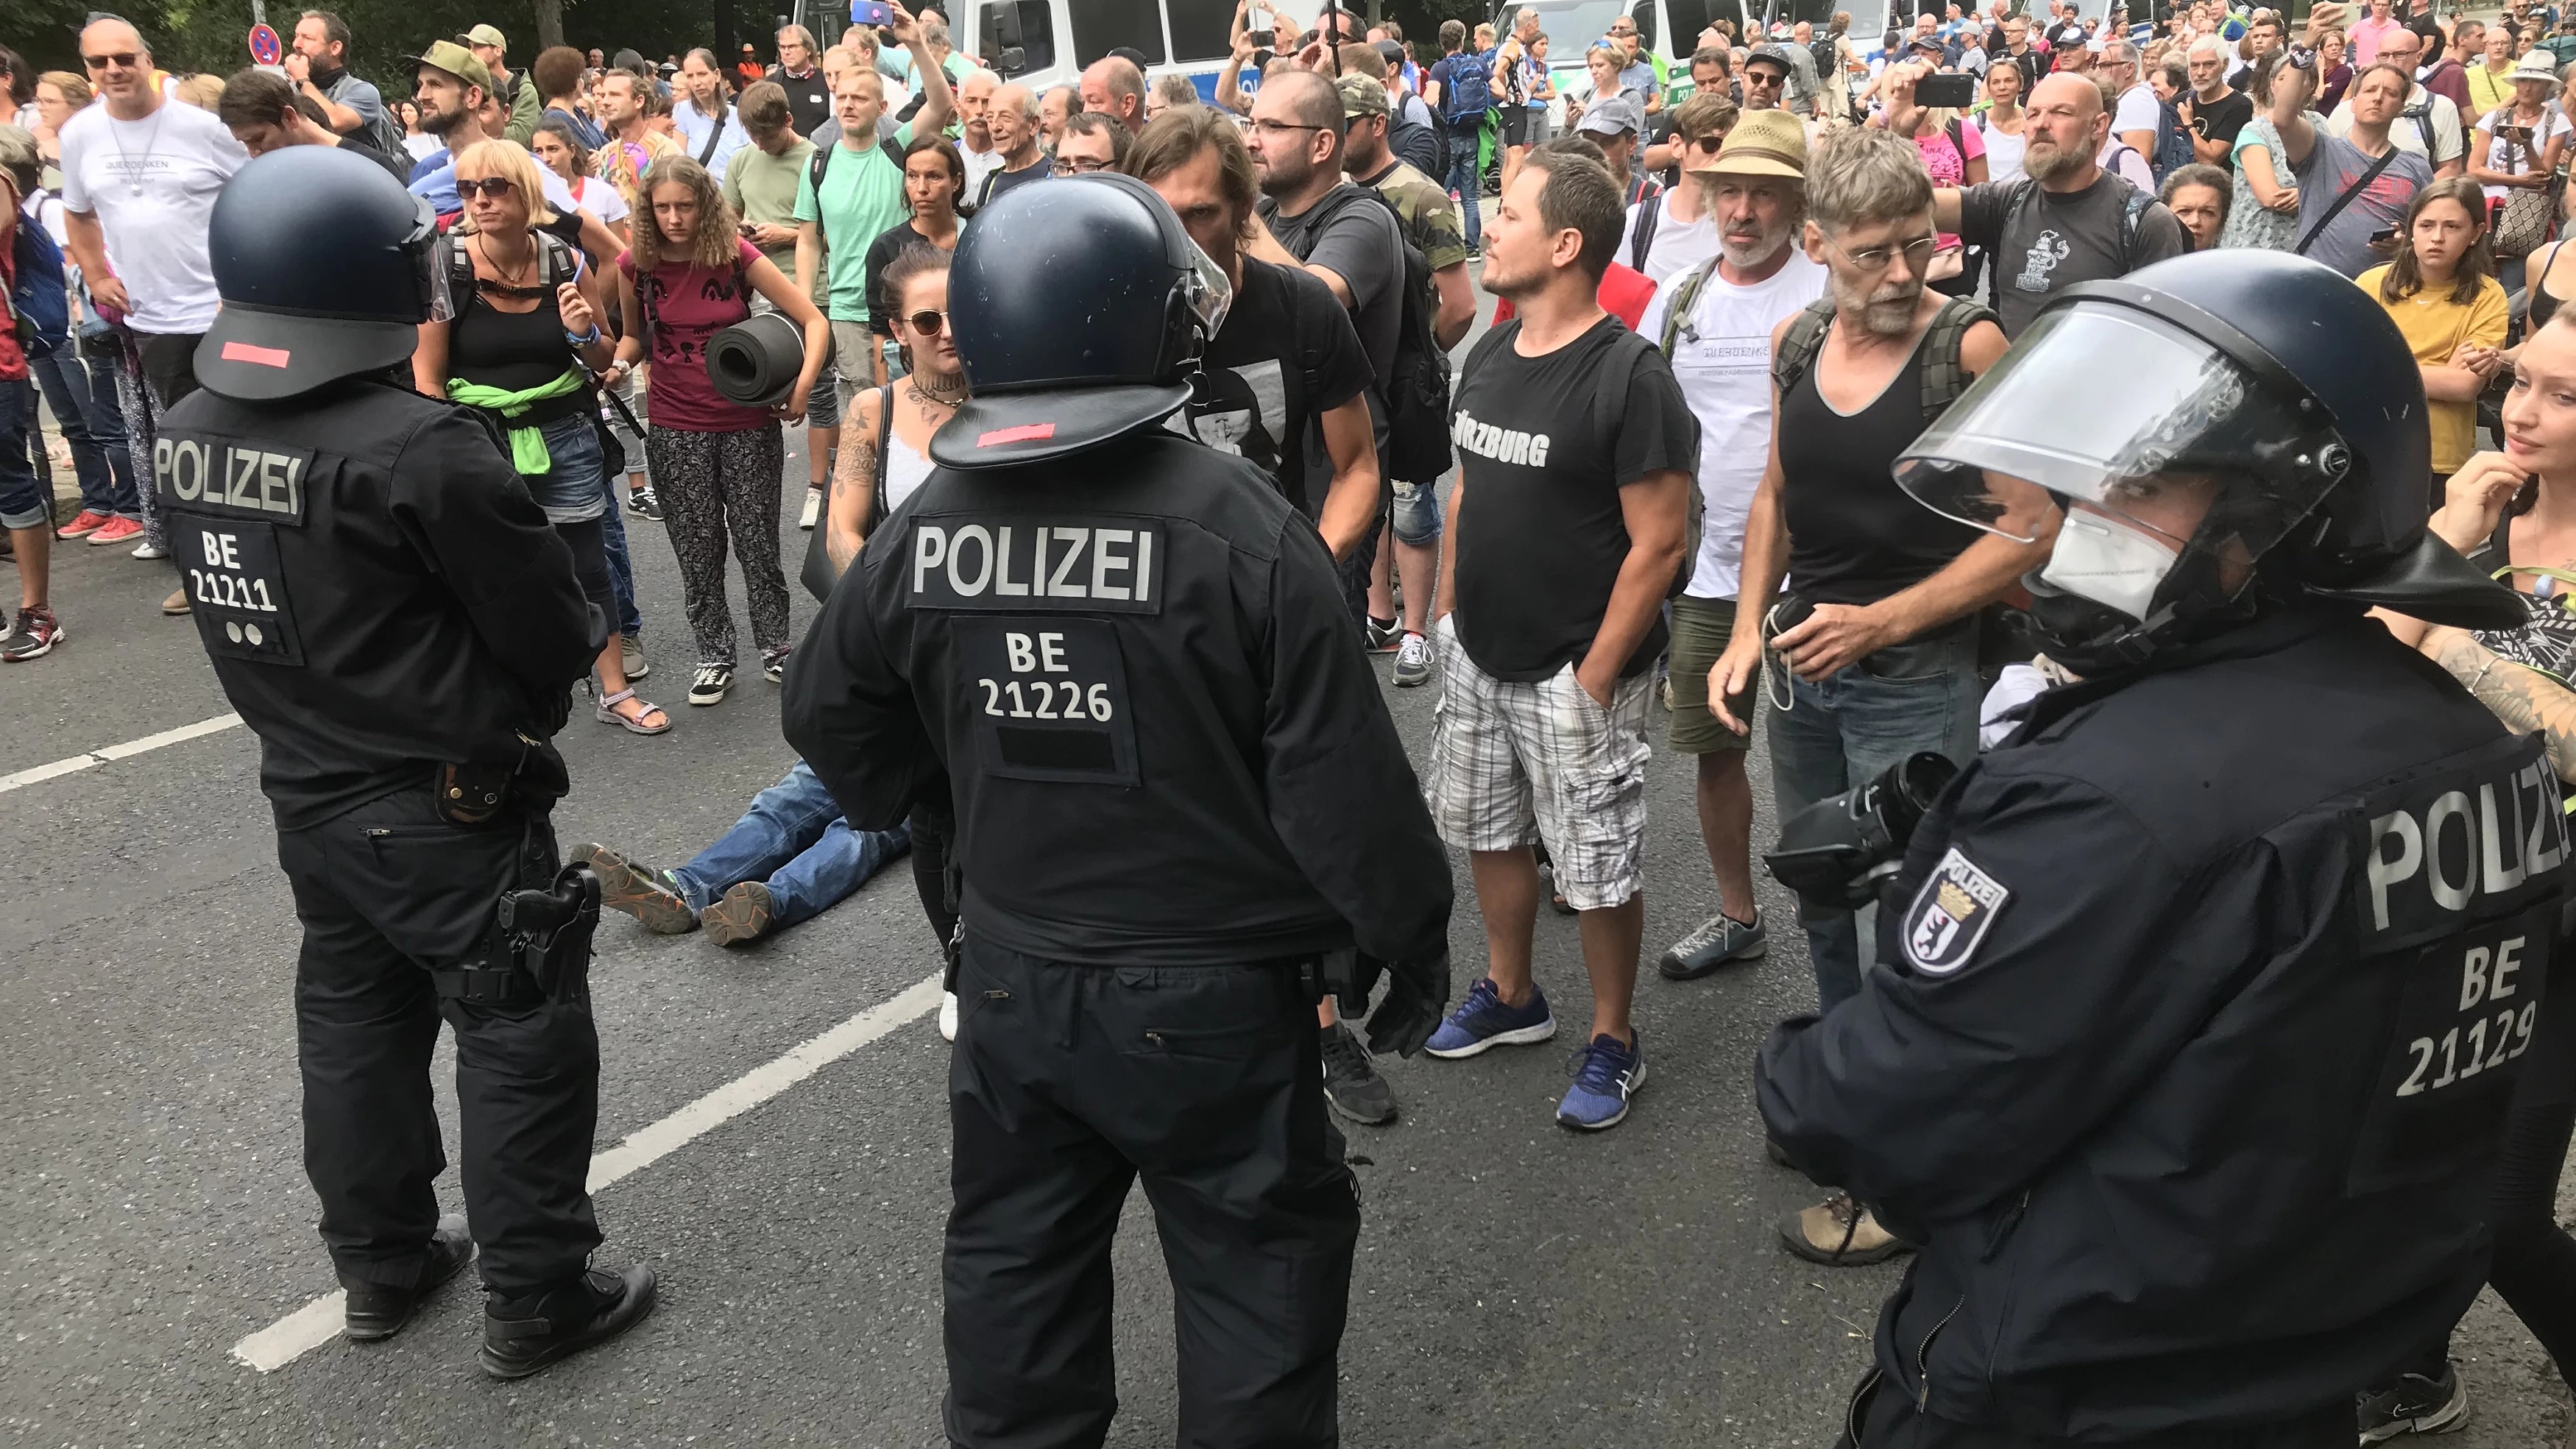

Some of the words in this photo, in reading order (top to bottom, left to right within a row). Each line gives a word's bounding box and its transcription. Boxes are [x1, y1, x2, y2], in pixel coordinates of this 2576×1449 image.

[1702, 346, 1769, 358] QUERDENKE
[1454, 409, 1550, 467] ÜRZBURG
[155, 438, 302, 515] POLIZEI
[202, 531, 241, 569] BE
[913, 524, 1152, 601] POLIZEI
[190, 569, 277, 612] 21211
[1005, 632, 1069, 673] BE
[978, 679, 1112, 722] 21226
[2459, 935, 2525, 1012] BE
[2396, 1000, 2536, 1097] 21129
